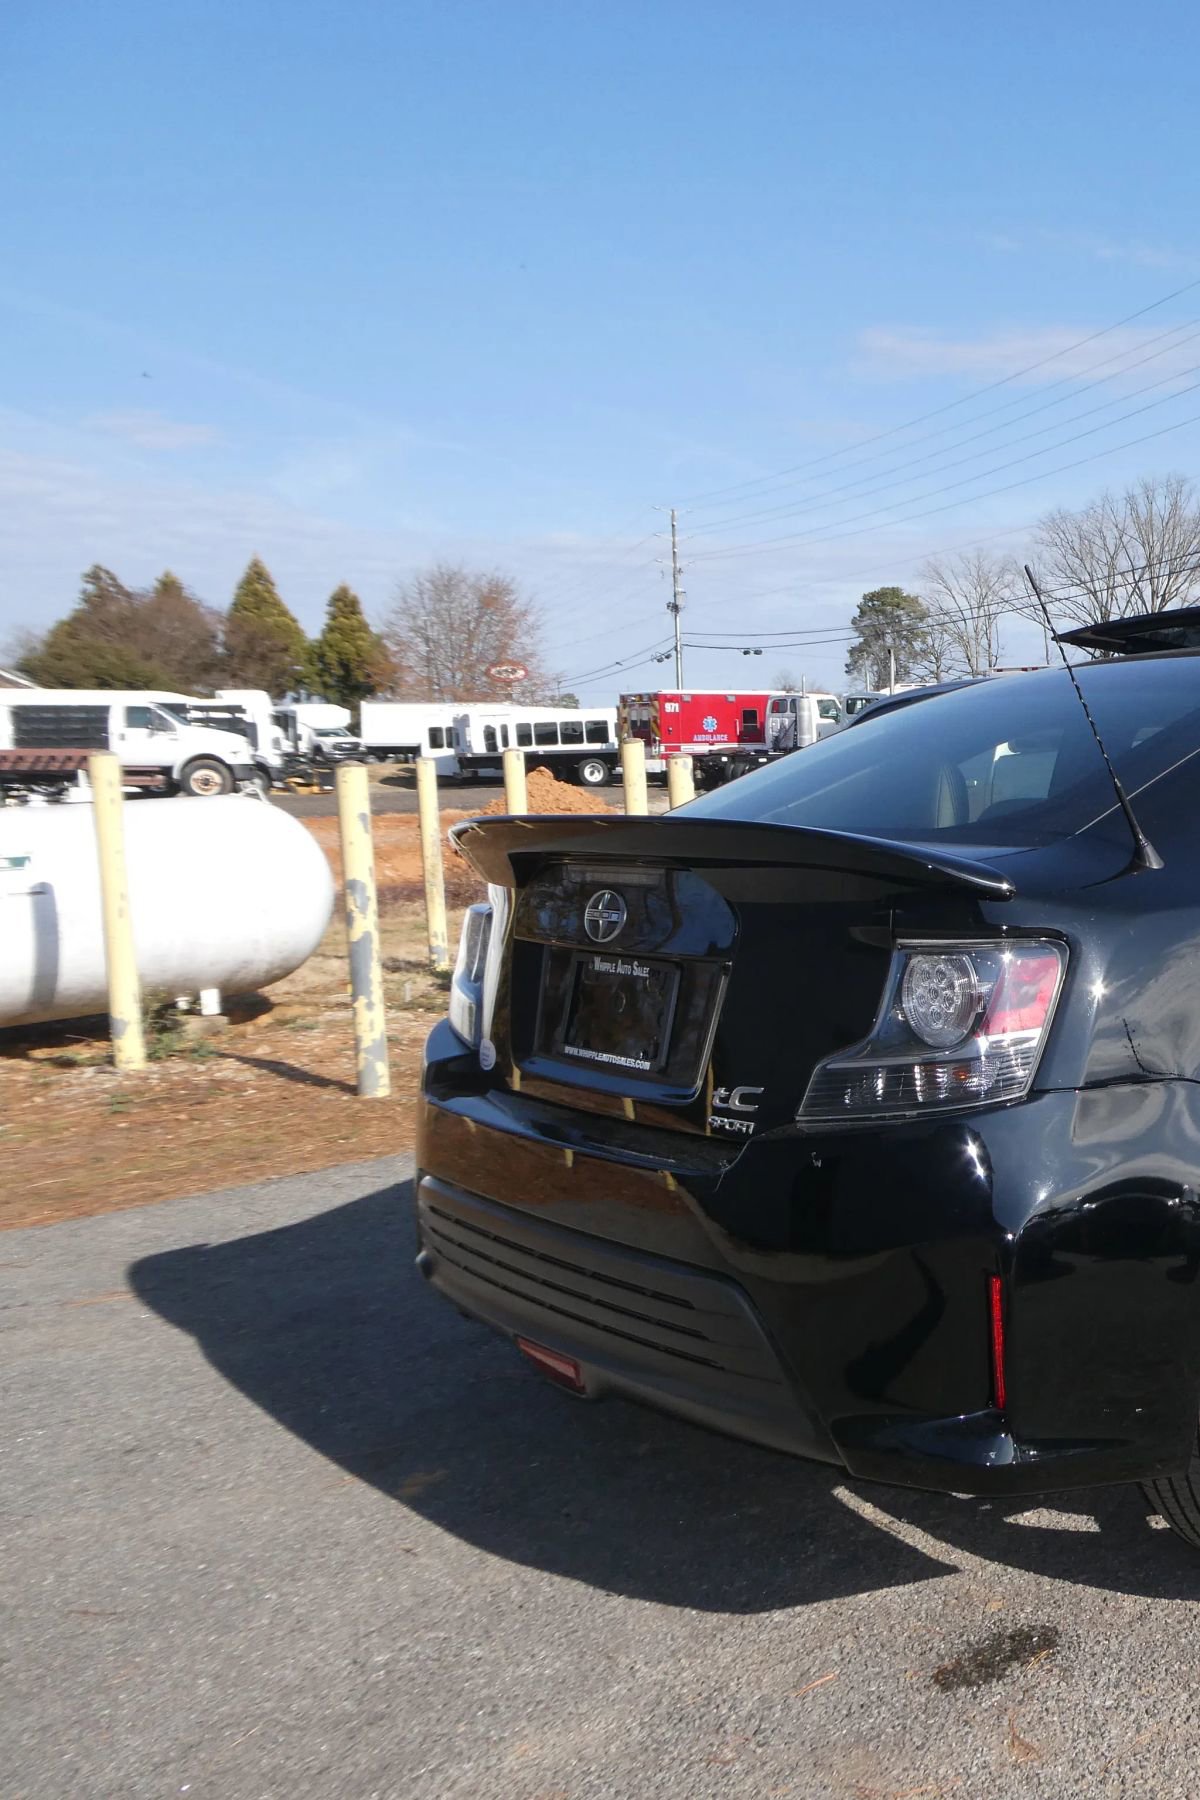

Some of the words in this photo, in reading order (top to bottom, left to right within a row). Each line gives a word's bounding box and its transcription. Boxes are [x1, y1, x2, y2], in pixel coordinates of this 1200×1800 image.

[664, 702, 680, 713] 971
[692, 734, 729, 742] AMBULANCE
[707, 1115, 755, 1134] SPORT
